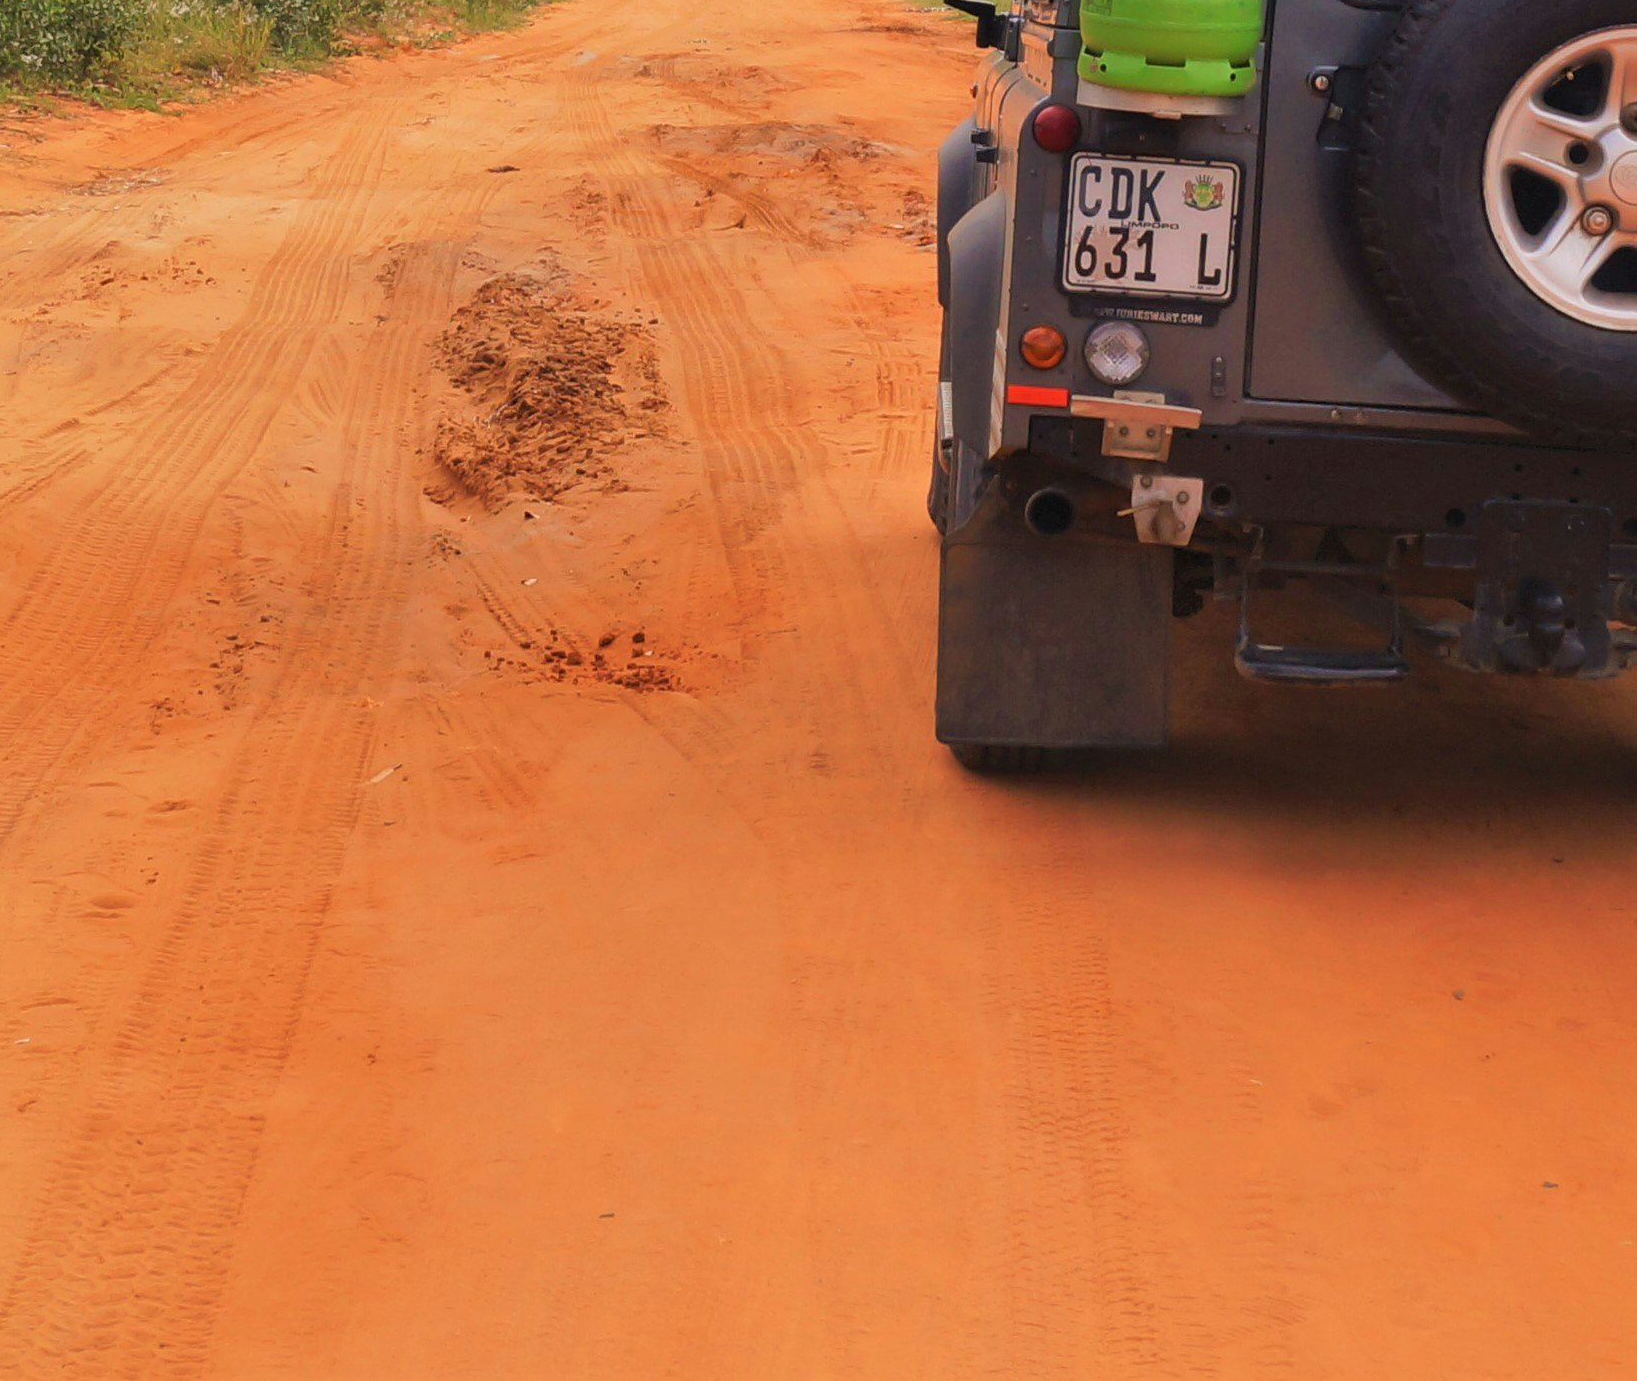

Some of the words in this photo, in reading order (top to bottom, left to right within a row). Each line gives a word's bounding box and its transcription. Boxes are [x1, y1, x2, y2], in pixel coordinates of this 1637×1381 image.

[1078, 165, 1165, 222] CDK
[1121, 220, 1179, 230] LIMPOPO
[1075, 226, 1157, 283] 631
[1197, 233, 1221, 286] L
